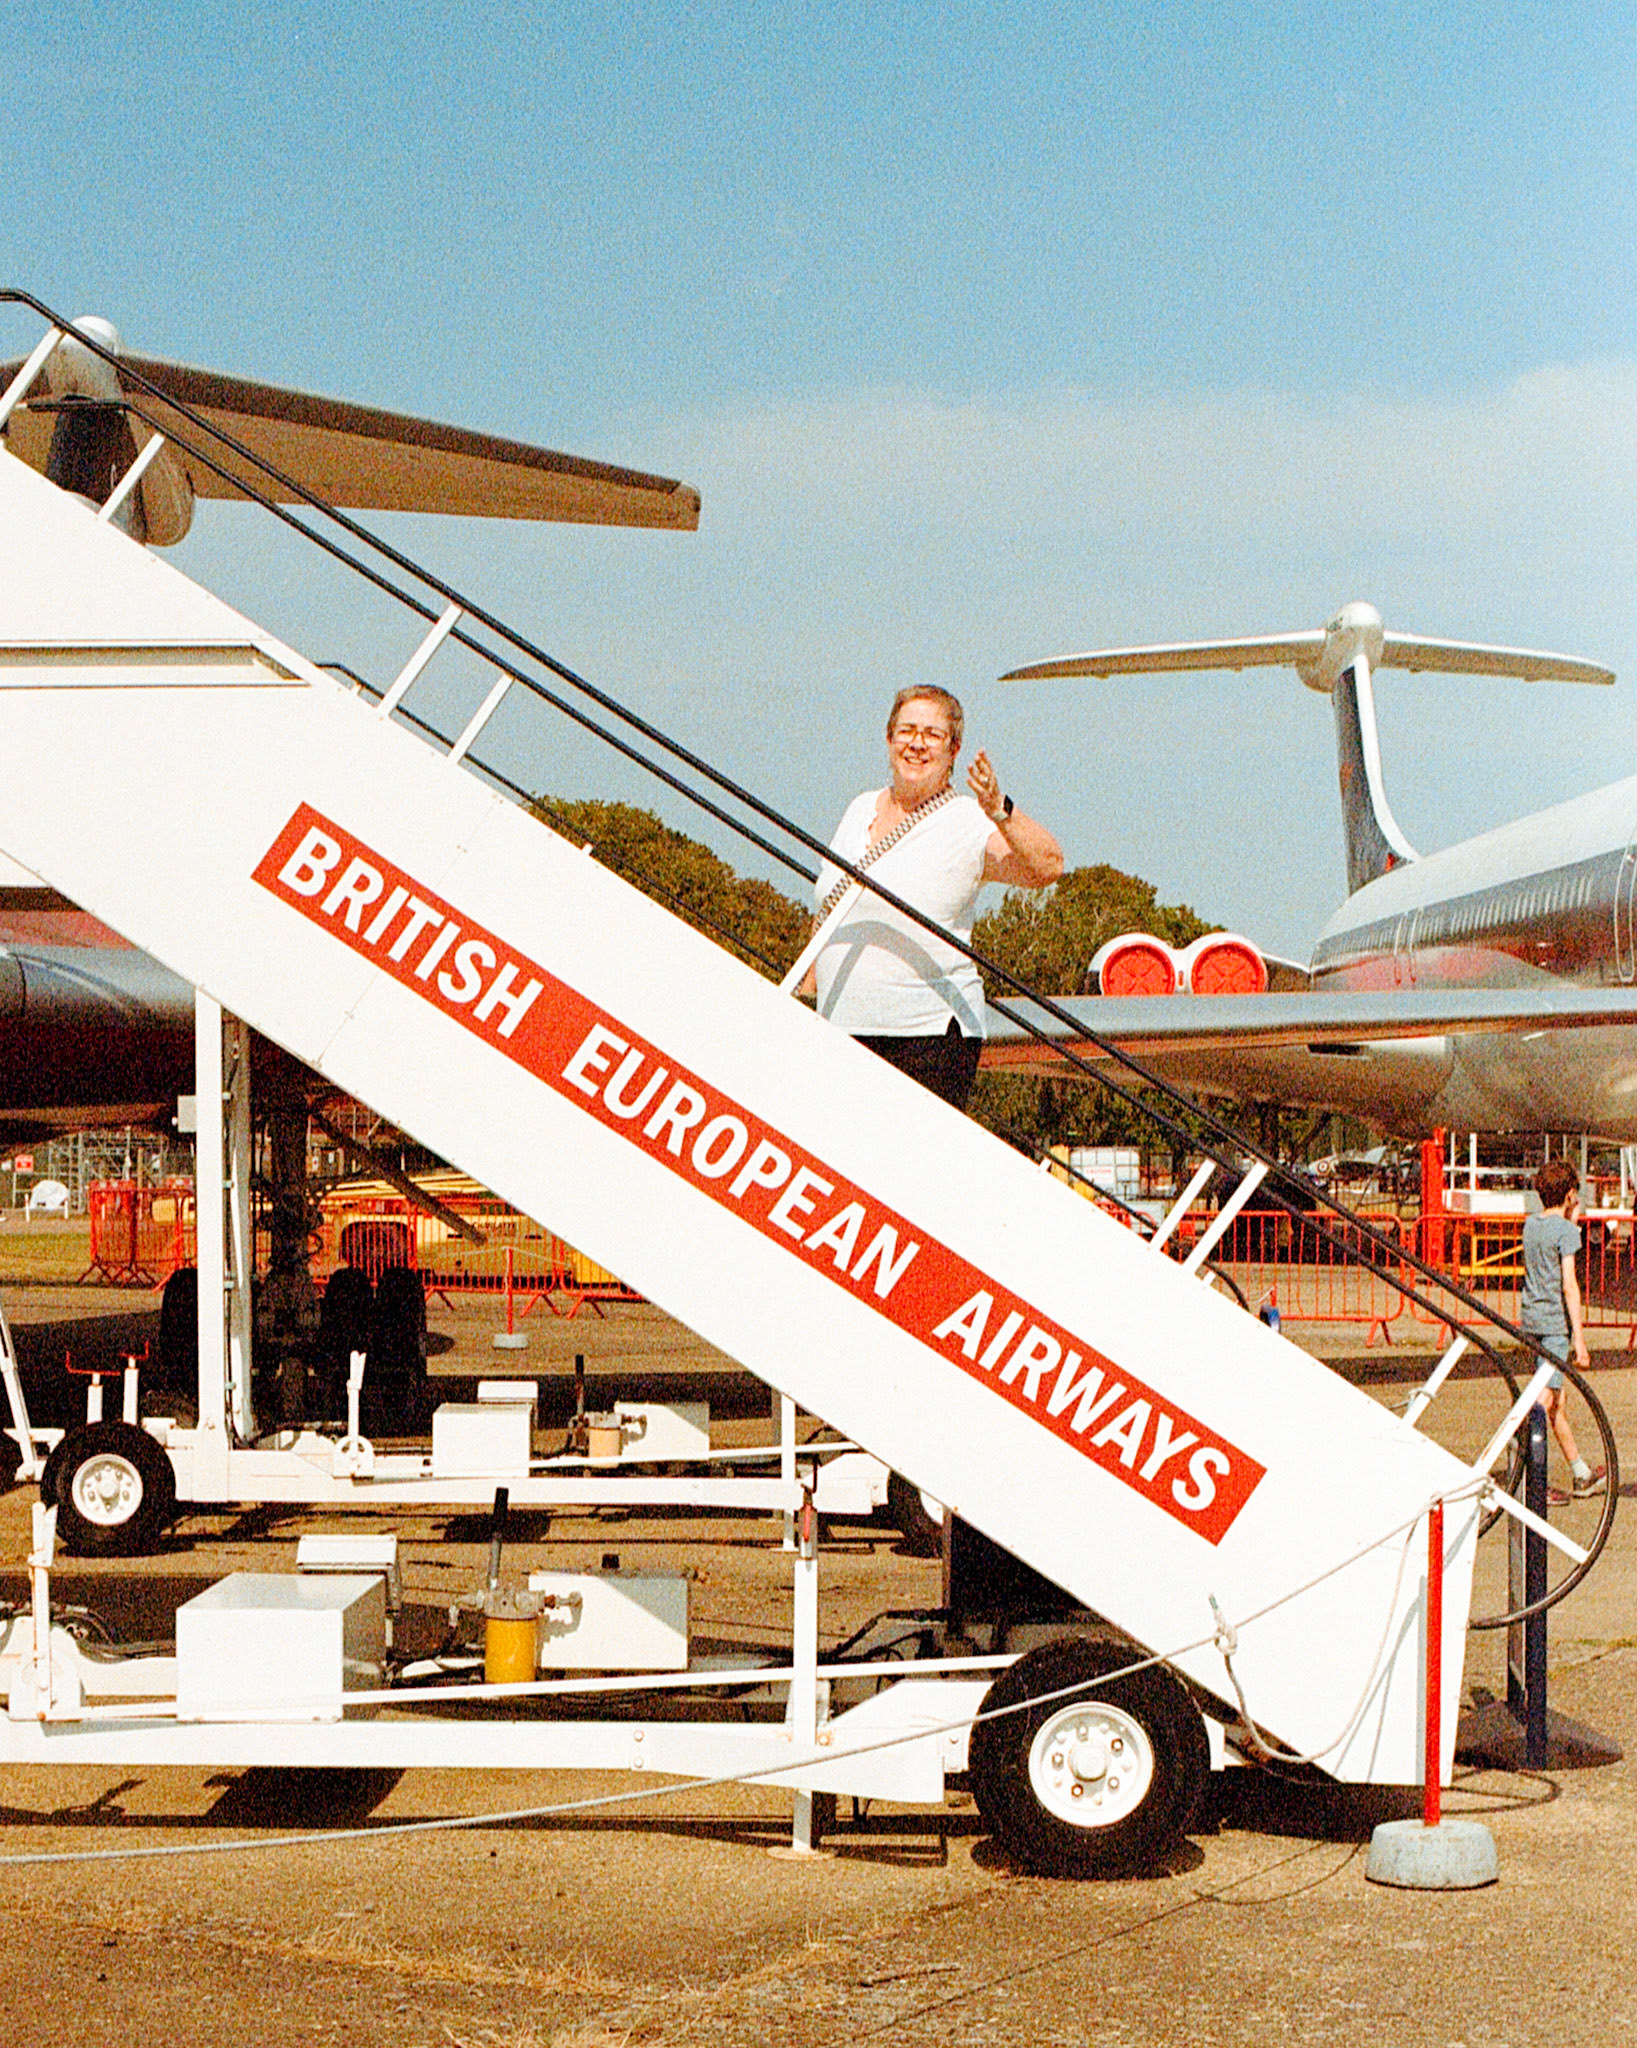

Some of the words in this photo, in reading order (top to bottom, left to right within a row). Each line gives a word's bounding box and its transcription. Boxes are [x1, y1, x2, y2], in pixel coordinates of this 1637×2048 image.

[277, 826, 544, 1039] BRITISH
[561, 1022, 921, 1300] EUROPEAN
[931, 1289, 1230, 1511] AIRWAYS
